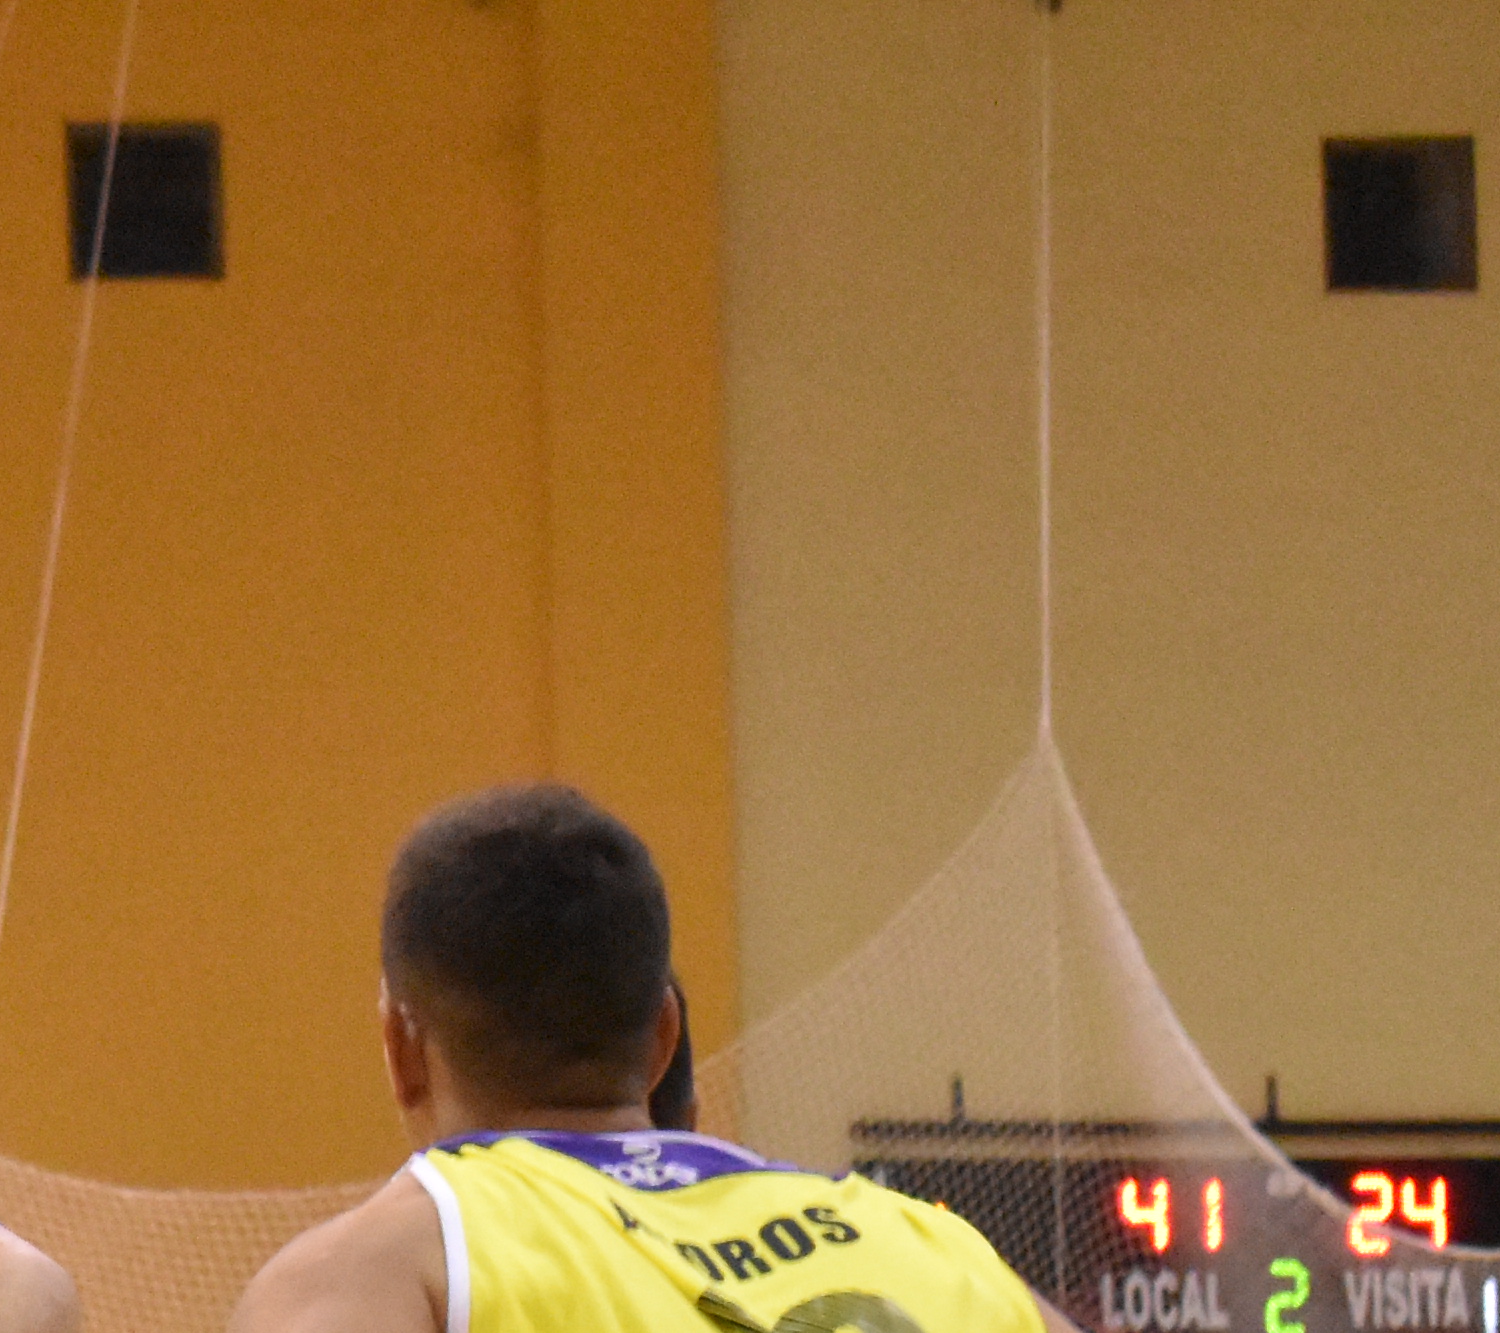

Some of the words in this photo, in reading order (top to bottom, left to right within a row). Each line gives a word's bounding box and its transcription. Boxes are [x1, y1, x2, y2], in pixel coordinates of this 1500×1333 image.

[1118, 1177, 1225, 1254] 41
[1346, 1170, 1449, 1258] 24
[1101, 1267, 1232, 1331] LOCAL
[1343, 1265, 1471, 1330] VISITA
